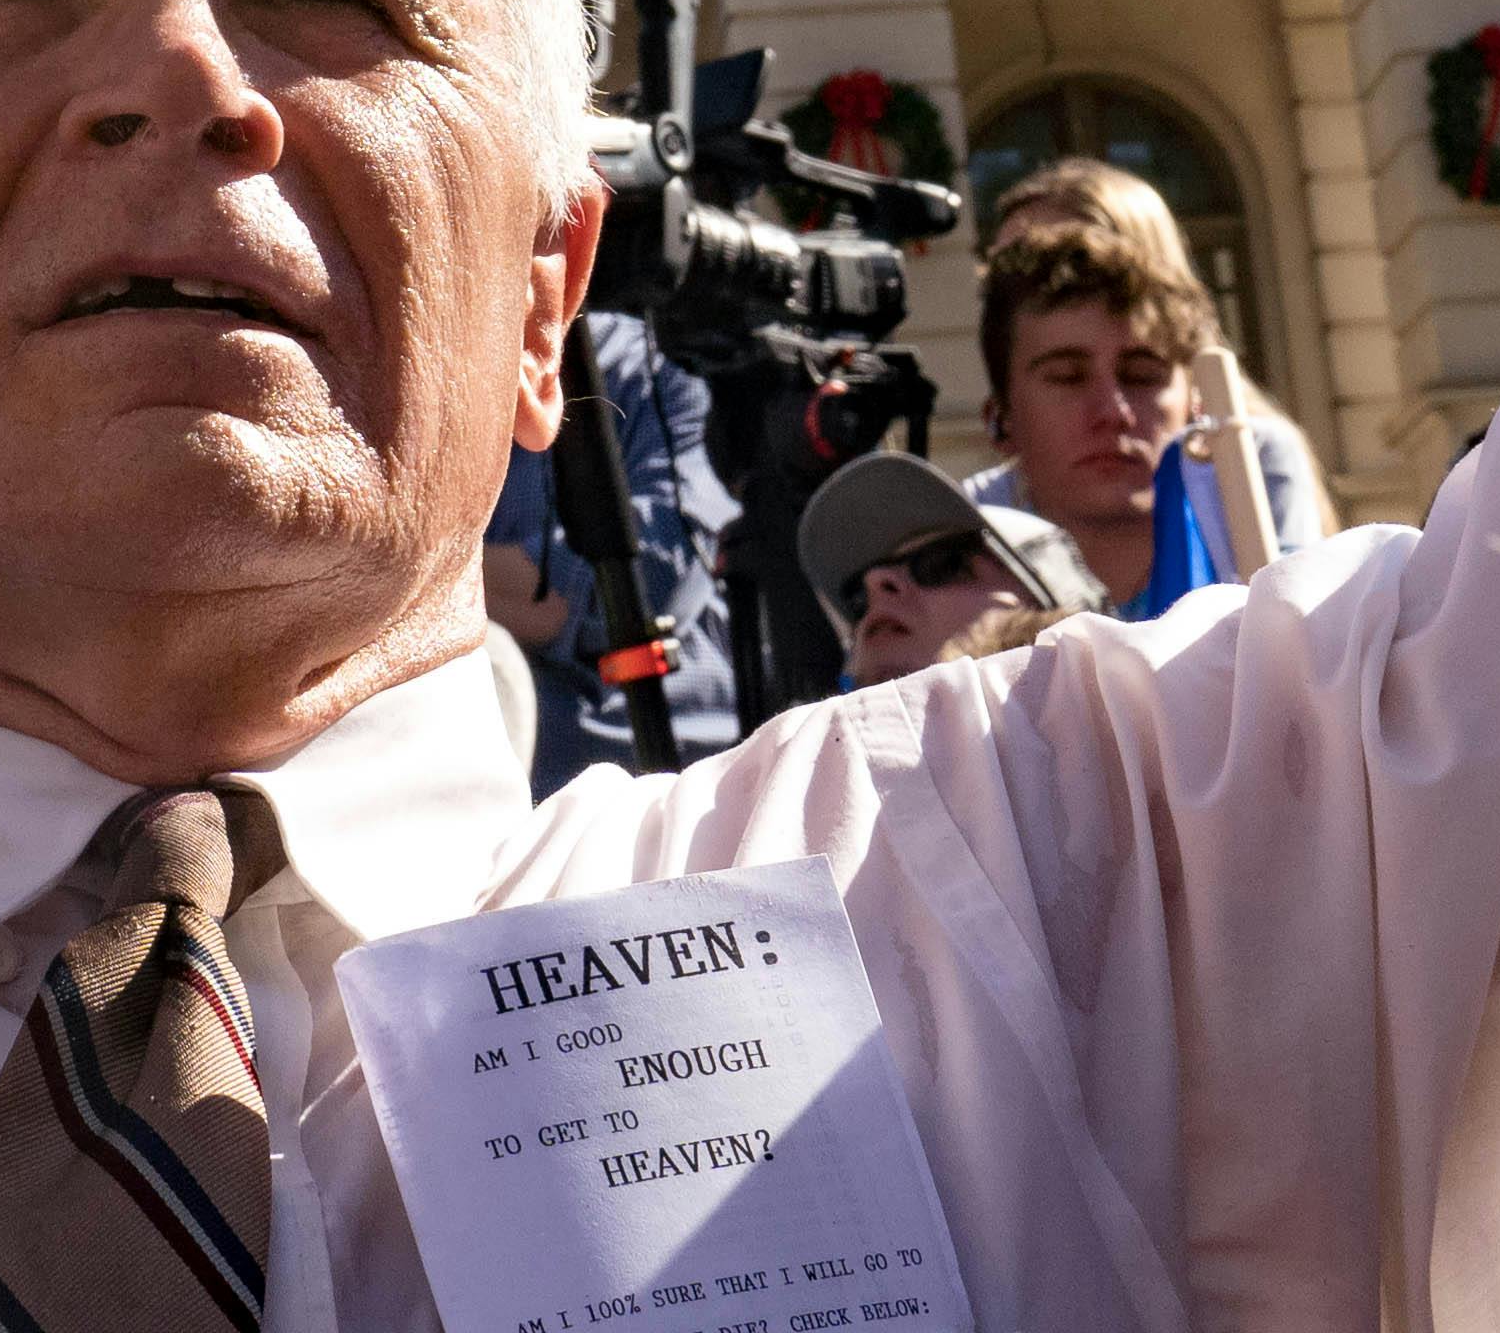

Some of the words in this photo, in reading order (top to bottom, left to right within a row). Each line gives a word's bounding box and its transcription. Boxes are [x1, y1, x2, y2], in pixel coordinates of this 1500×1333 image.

[482, 921, 778, 1015] HEAVEN:
[474, 1047, 509, 1074] AM
[522, 1040, 540, 1061] I
[556, 1023, 623, 1054] GOOD
[614, 1039, 770, 1088] ENOUGH
[484, 1134, 522, 1160] TO
[538, 1119, 589, 1147] GET
[603, 1109, 639, 1134] TO
[599, 1129, 774, 1188] HEAVEN?
[557, 1311, 573, 1330] I
[584, 1293, 642, 1324] 100%
[651, 1282, 706, 1308] SURE
[715, 1271, 769, 1296] THAT
[779, 1267, 794, 1285] I
[801, 1258, 855, 1282] WILL
[863, 1253, 888, 1272] GO
[896, 1248, 923, 1267] TO
[790, 1306, 853, 1333] CHECK
[859, 1297, 929, 1321] BELOW:
